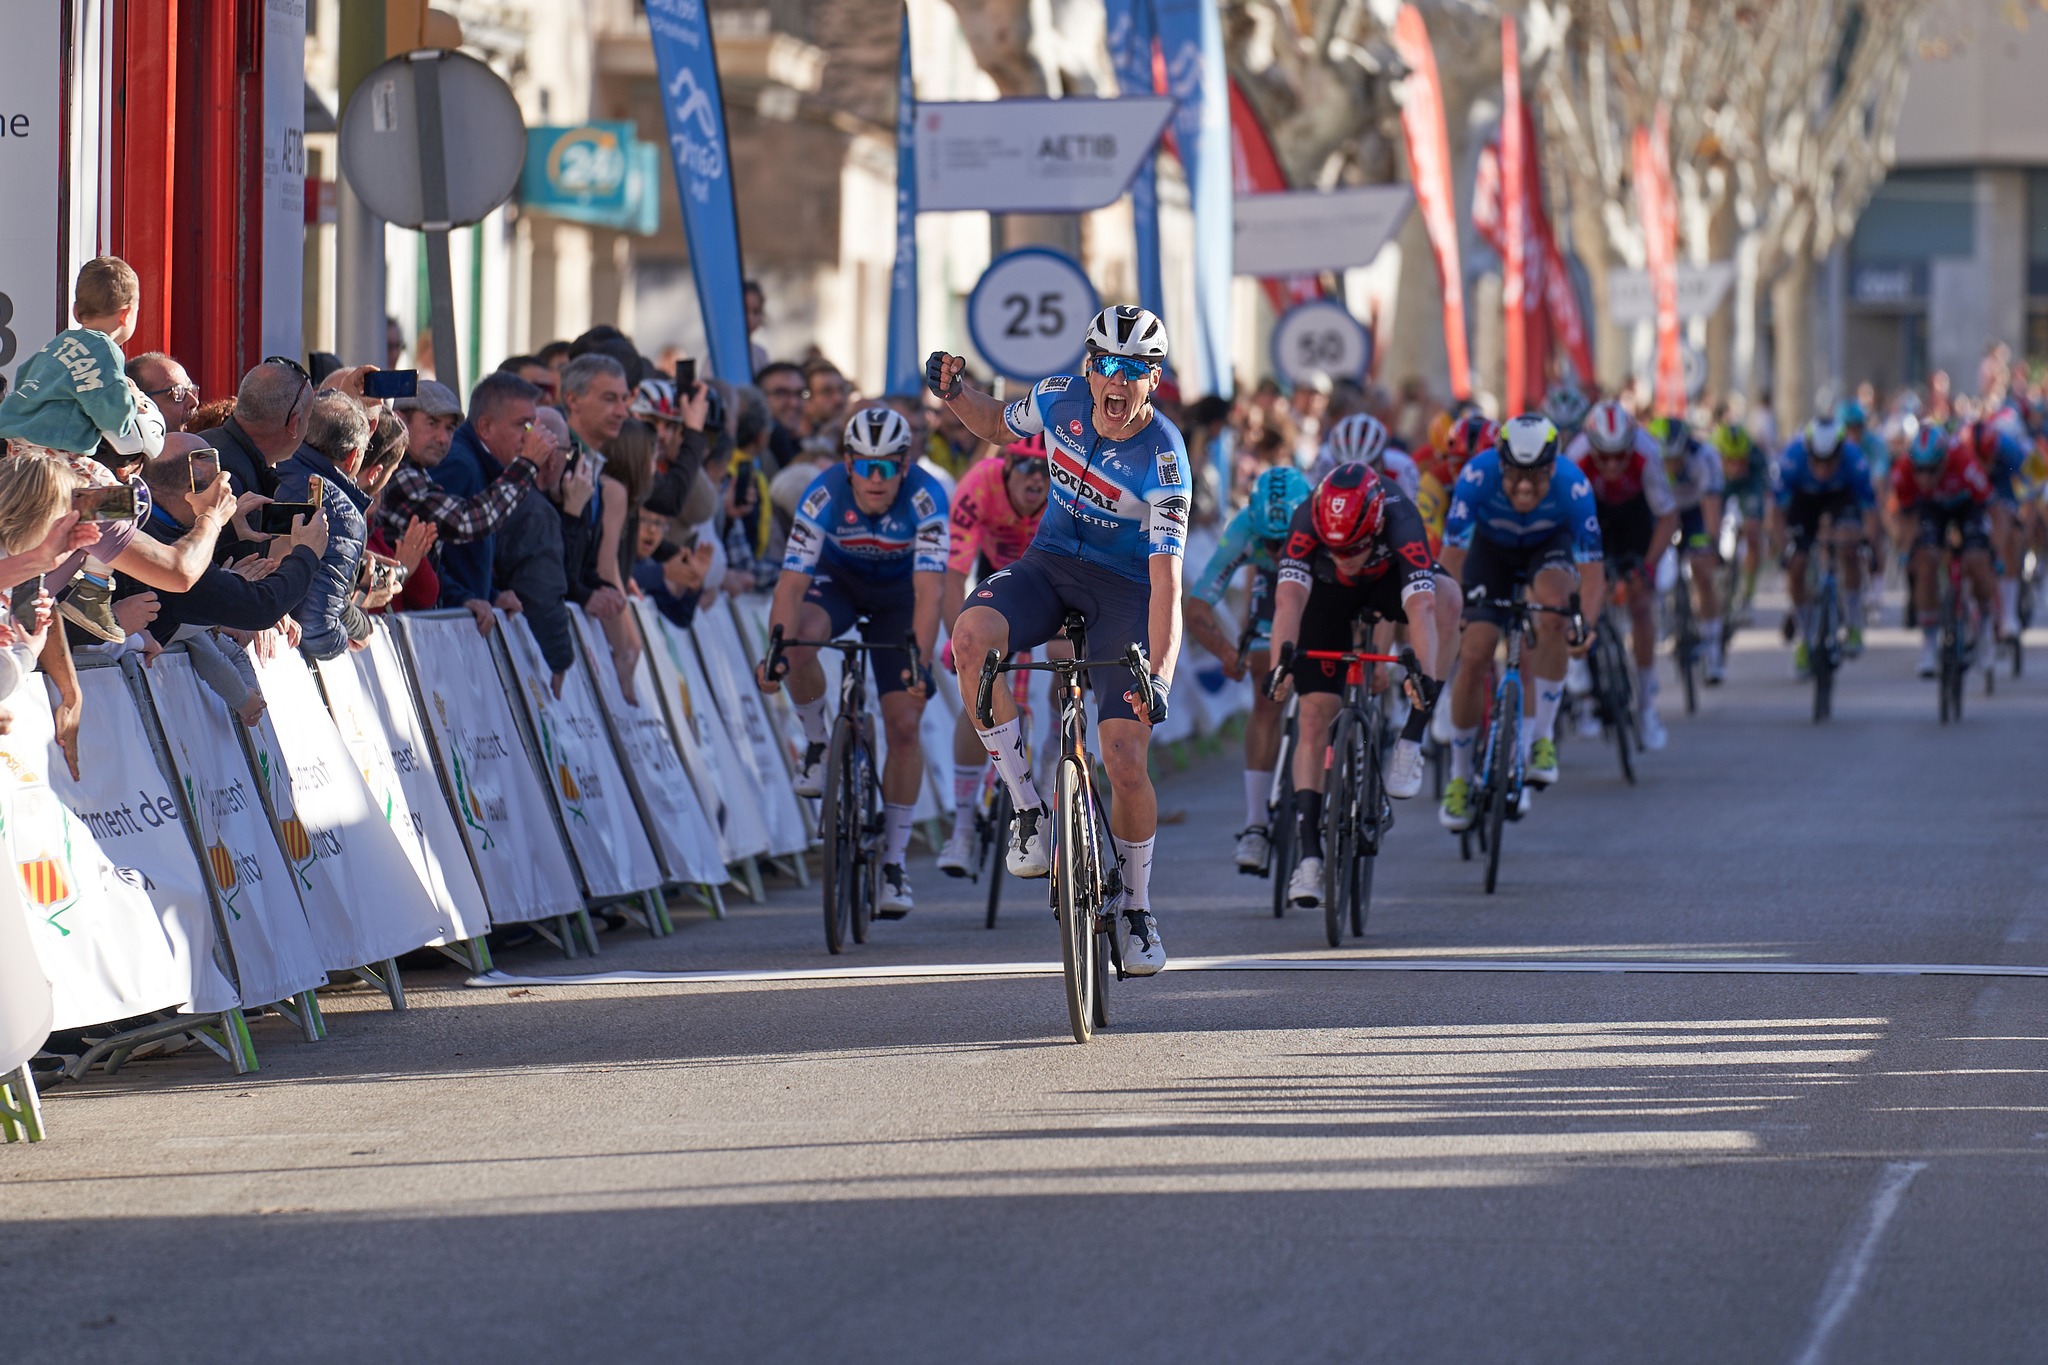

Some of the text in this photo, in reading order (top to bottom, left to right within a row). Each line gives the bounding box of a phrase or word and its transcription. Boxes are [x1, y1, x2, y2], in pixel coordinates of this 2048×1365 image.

[1038, 134, 1118, 161] AETIB
[1003, 293, 1066, 338] 25
[52, 336, 104, 393] TEAM
[1298, 328, 1345, 368] 50
[1055, 425, 1088, 456] Ekopak
[1050, 463, 1118, 513] SOUDAL
[138, 790, 179, 828] de
